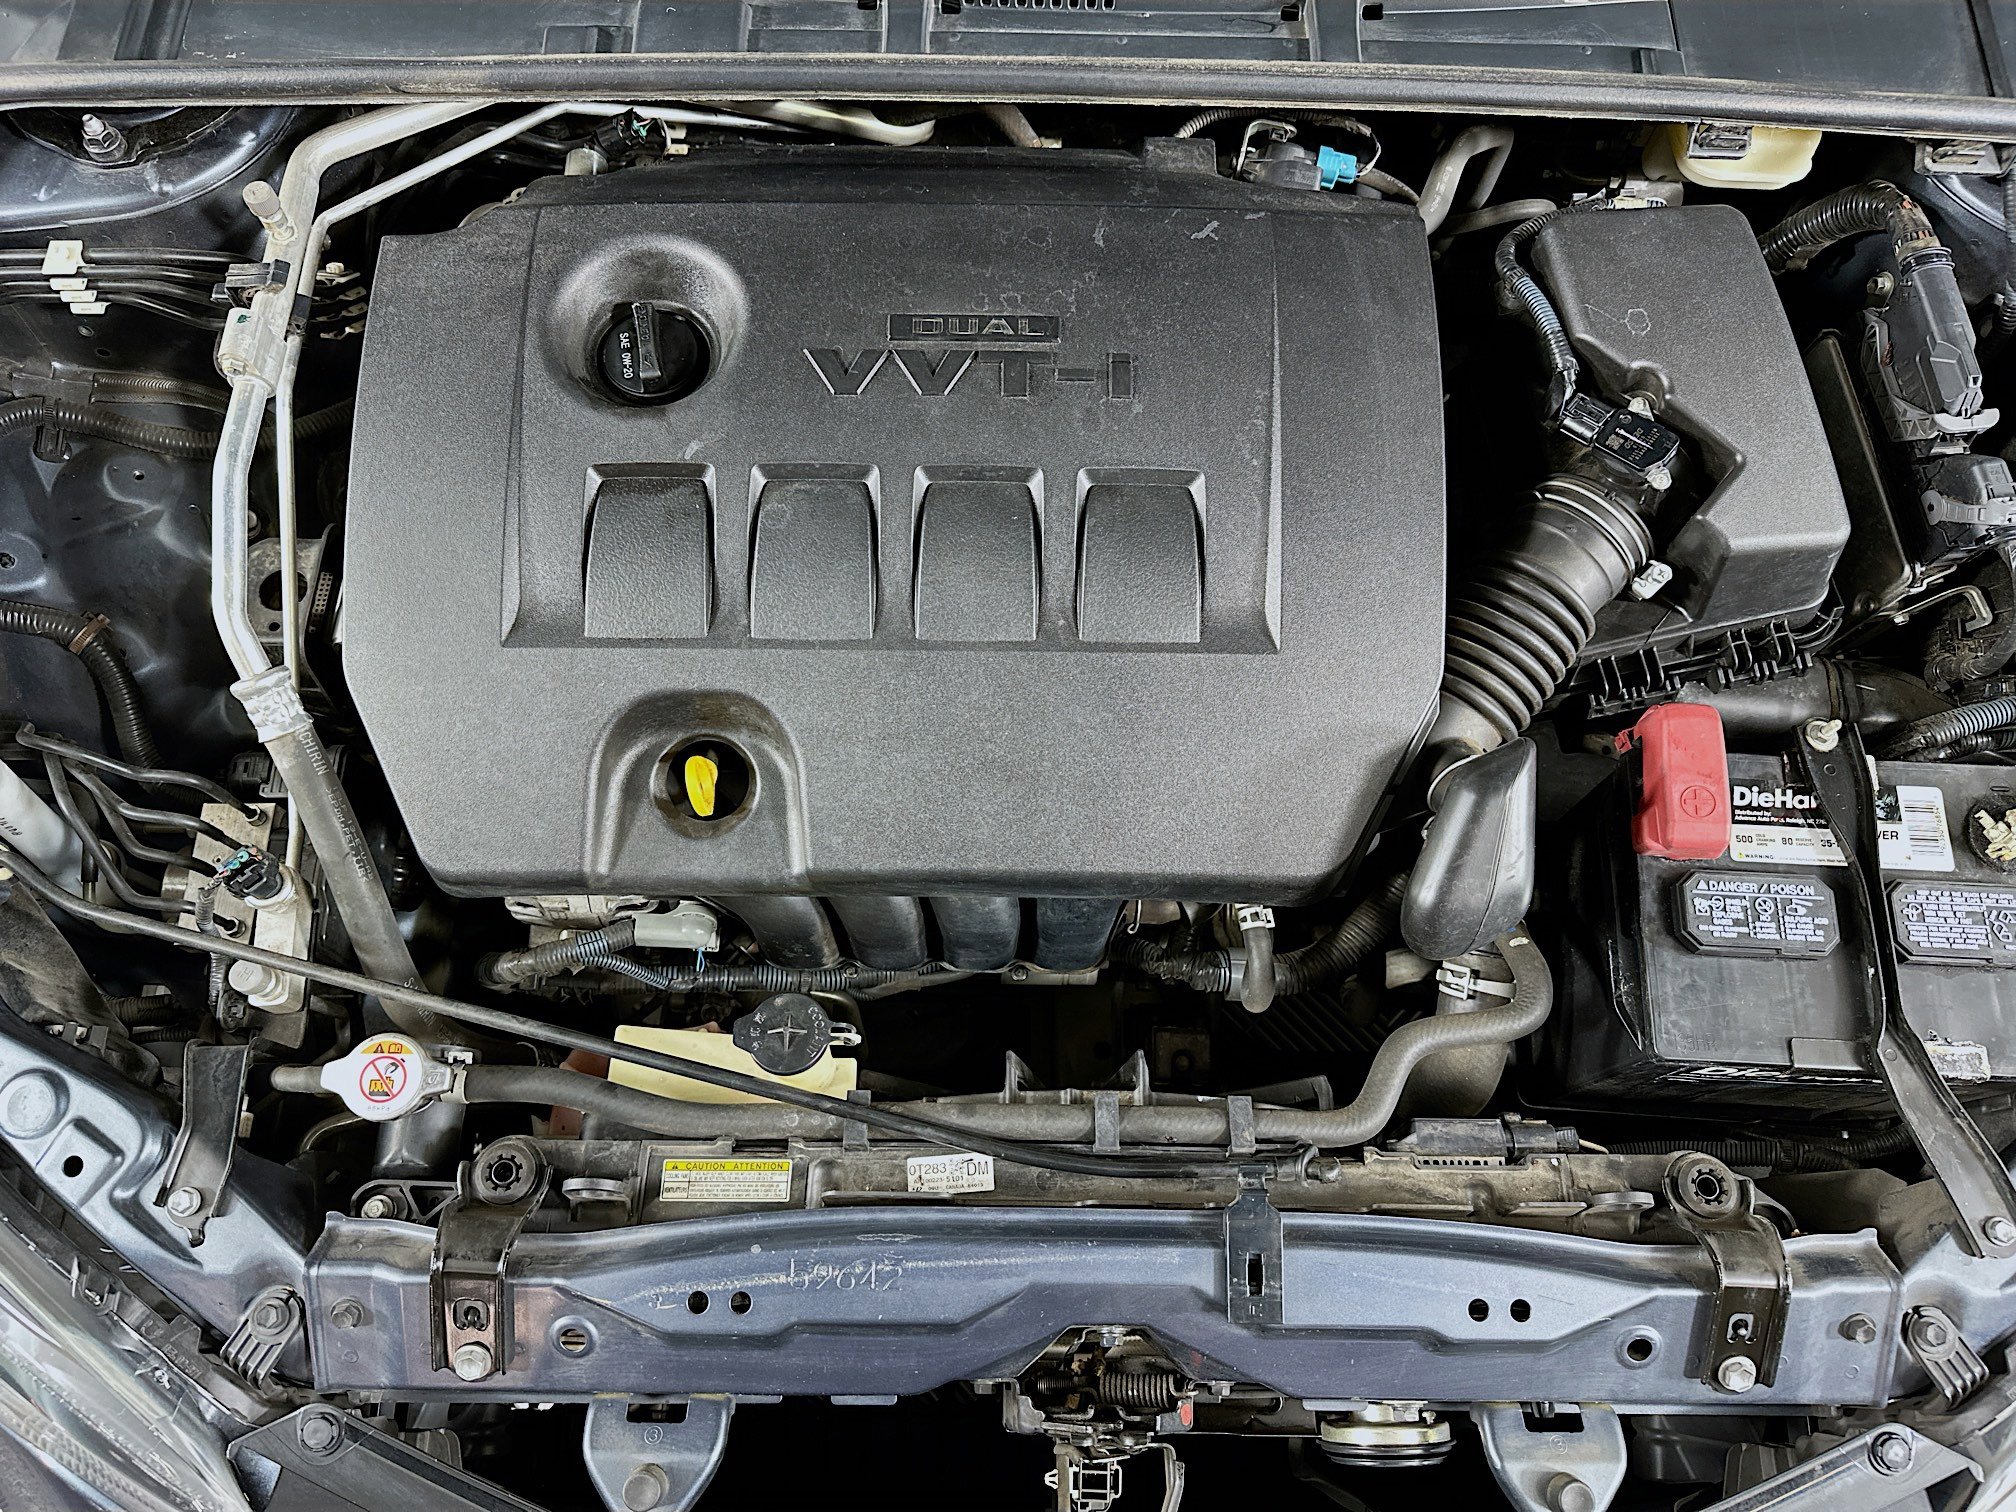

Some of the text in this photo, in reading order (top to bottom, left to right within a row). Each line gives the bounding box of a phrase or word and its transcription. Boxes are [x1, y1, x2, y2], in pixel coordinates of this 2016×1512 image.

[912, 317, 1045, 336] DUAL
[619, 332, 634, 380] SAE 0W-20
[1624, 427, 1644, 449] DESO
[1735, 834, 1754, 843] 500
[1781, 837, 1794, 845] 80
[1708, 880, 1758, 894] DANGER
[1769, 884, 1815, 896] POISON
[685, 1161, 784, 1170] CAUTION ATTENTION
[966, 1160, 990, 1176] DM
